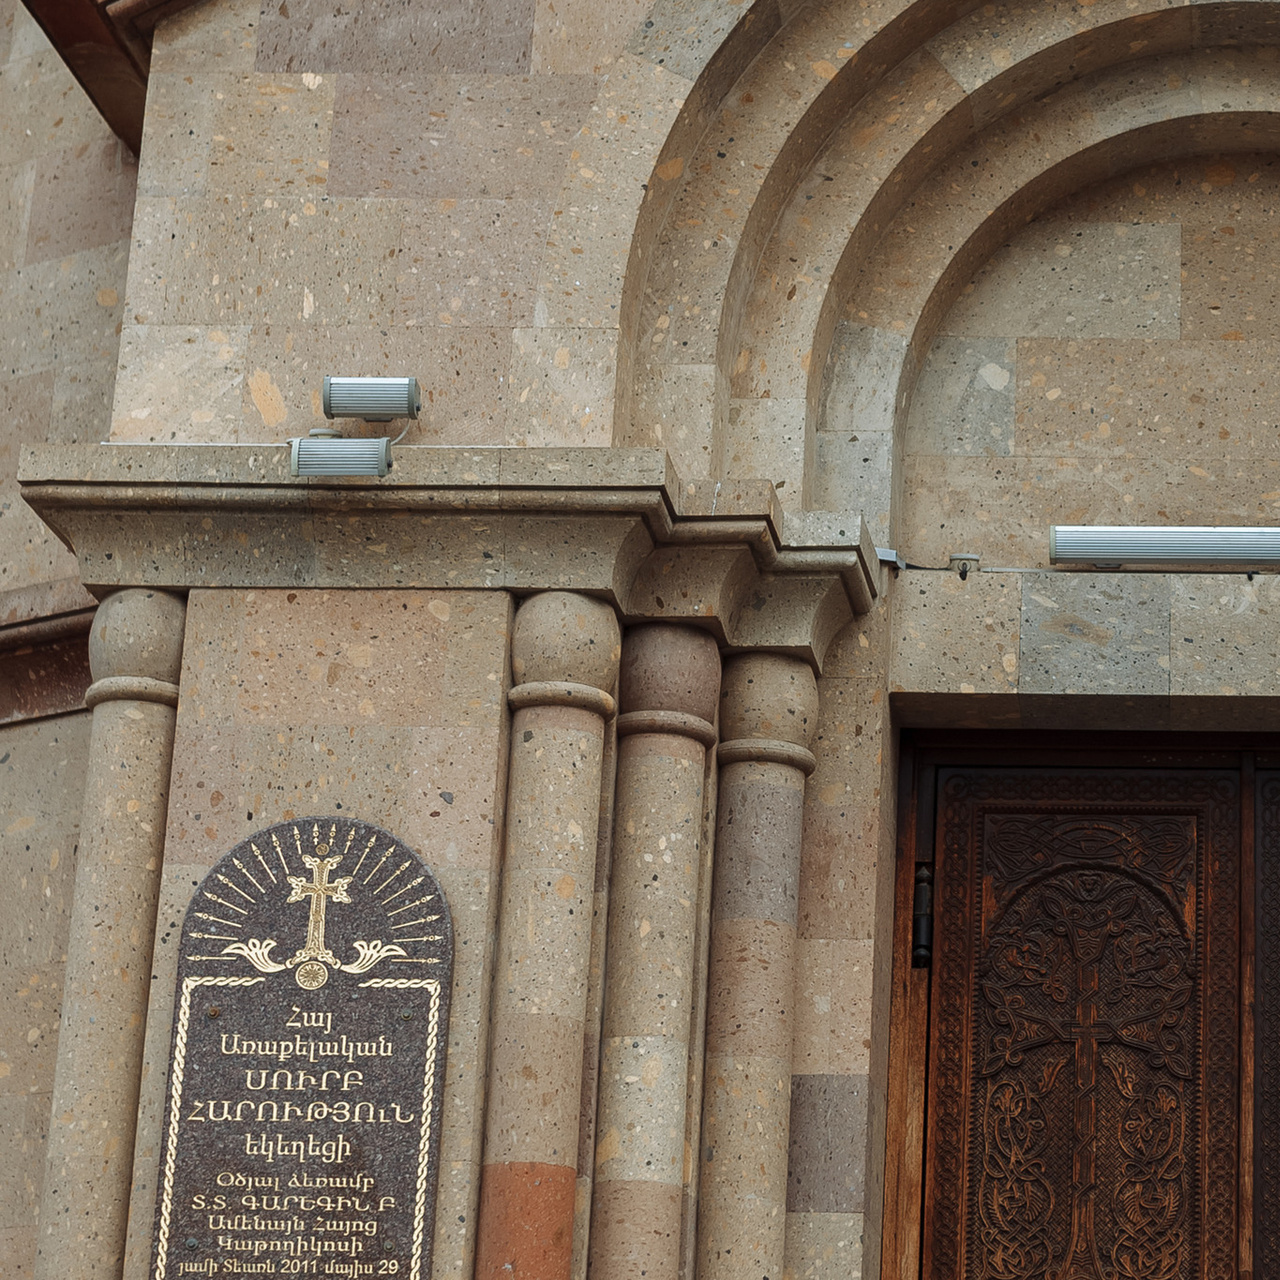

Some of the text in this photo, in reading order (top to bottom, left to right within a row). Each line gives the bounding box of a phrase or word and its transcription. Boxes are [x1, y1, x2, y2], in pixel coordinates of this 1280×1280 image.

[286, 1004, 332, 1034] Հայ
[221, 1034, 393, 1062] Առաքելական
[245, 1070, 363, 1090] ՍՈՒՐԲ
[246, 1134, 351, 1163] եկեղեցի
[216, 1172, 374, 1192] Օծյալ ձեռամբ
[242, 1195, 370, 1212] ԳԱՐԵԳԻՆ
[378, 1197, 396, 1212] Բ
[208, 1215, 377, 1236] Ամենայն Հայոց
[218, 1236, 363, 1256] Կաթողիկոսի
[178, 1259, 398, 1278] յամի Տեառն 2011 մայիս 29
